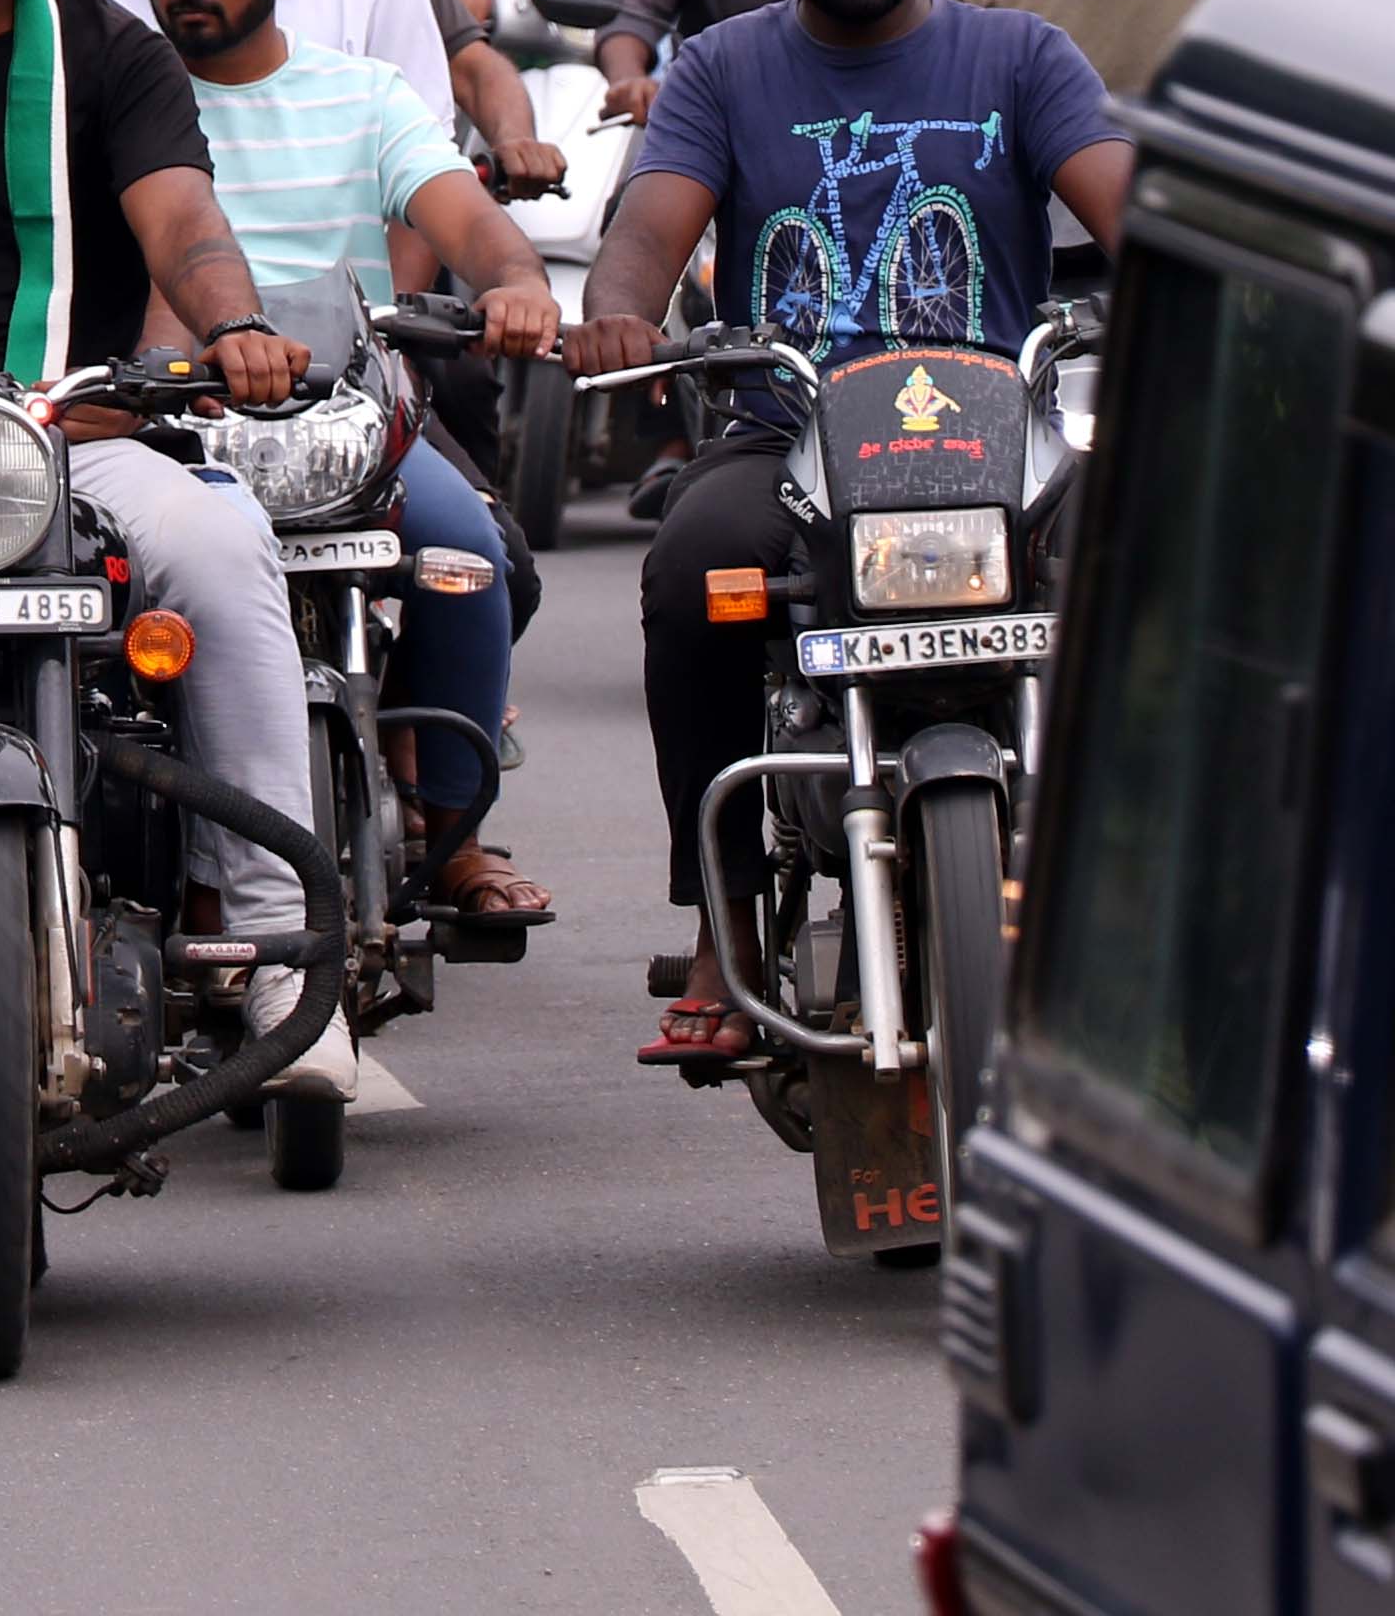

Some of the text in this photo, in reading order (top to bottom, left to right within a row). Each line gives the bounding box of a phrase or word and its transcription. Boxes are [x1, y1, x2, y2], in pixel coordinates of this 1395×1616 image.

[323, 540, 393, 562] 7743
[17, 594, 94, 622] 4856
[844, 635, 883, 666] KA
[989, 622, 1056, 654] 383
